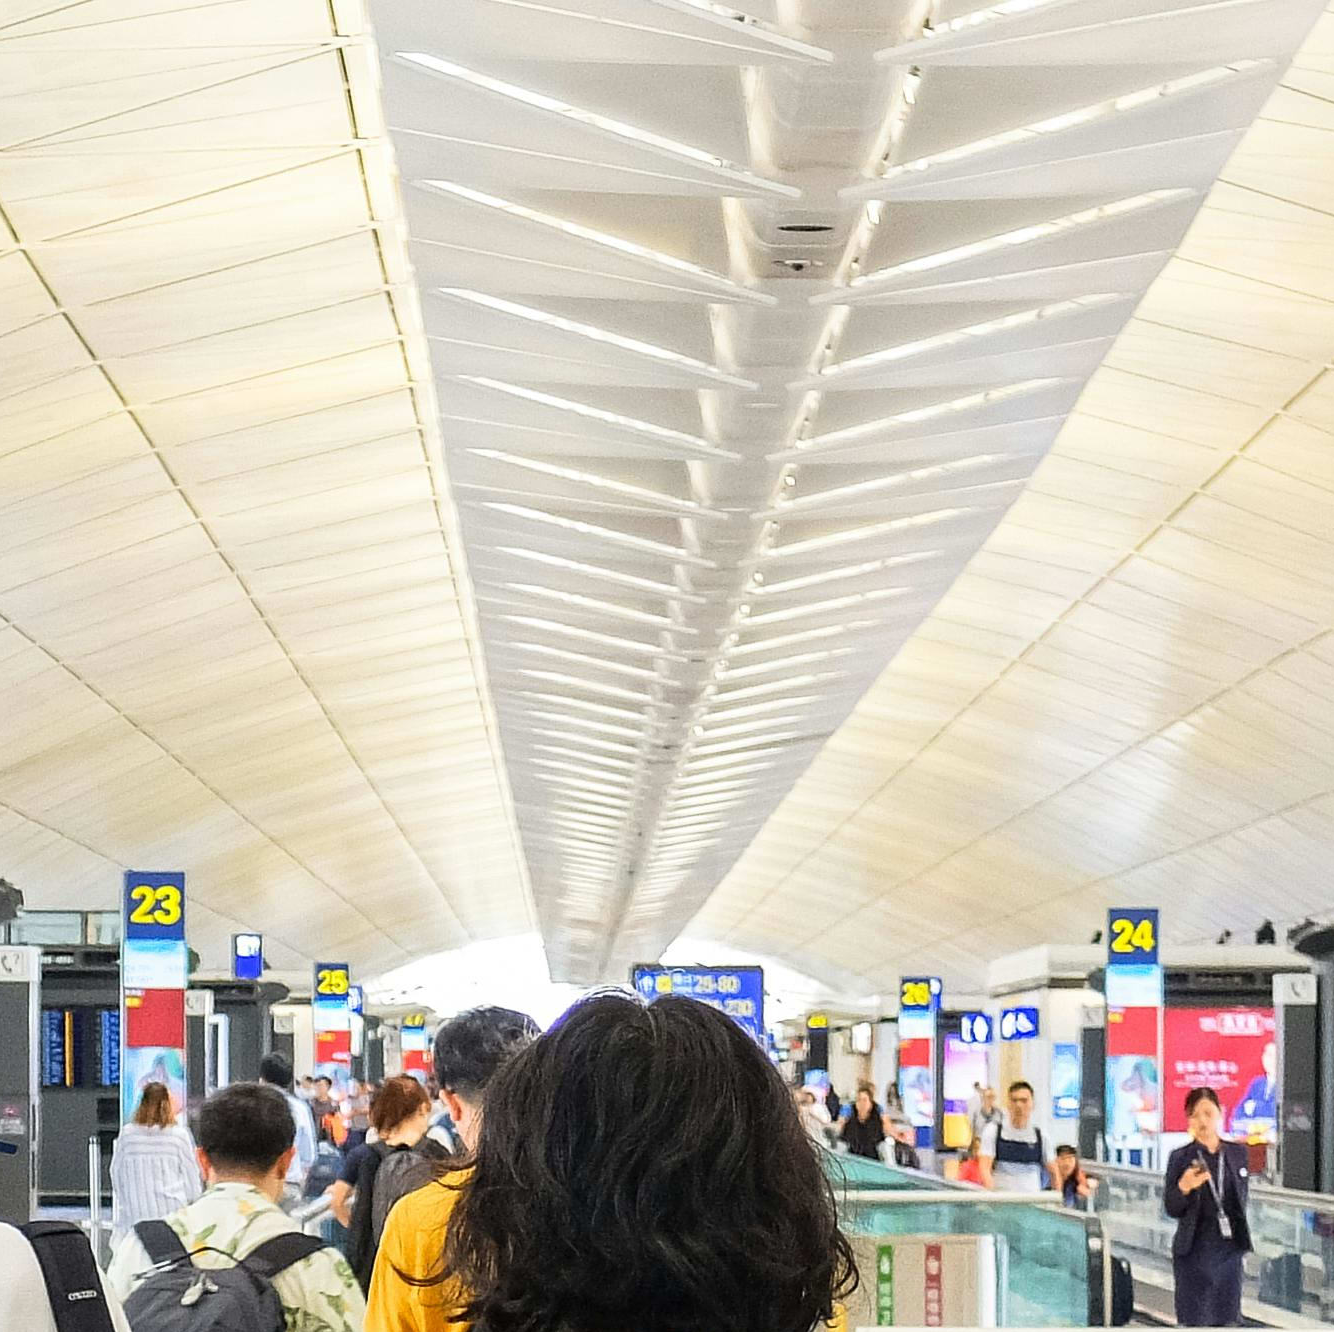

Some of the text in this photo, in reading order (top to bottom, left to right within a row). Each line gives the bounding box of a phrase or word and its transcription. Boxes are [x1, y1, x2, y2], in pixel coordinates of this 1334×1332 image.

[130, 885, 182, 925] 23
[1111, 919, 1155, 953] 24
[317, 969, 349, 995] 25
